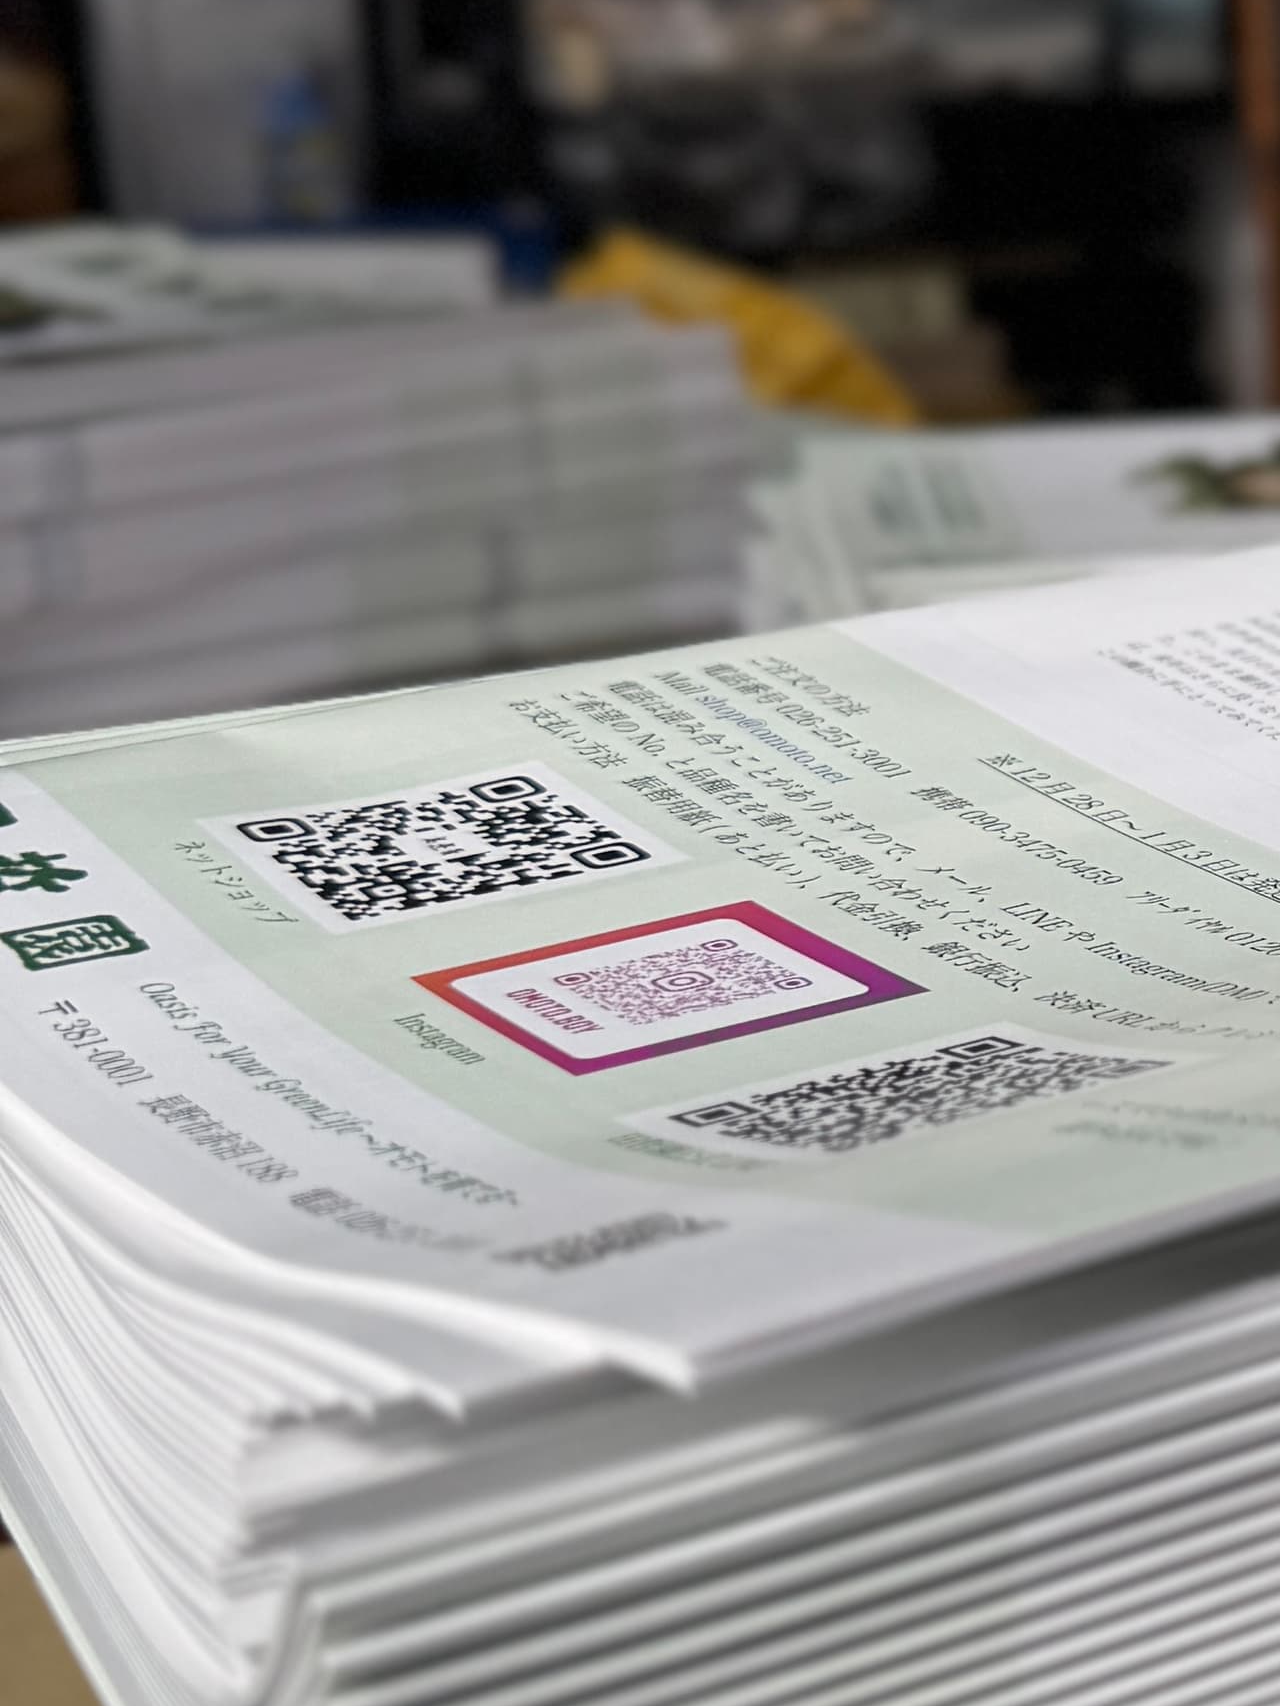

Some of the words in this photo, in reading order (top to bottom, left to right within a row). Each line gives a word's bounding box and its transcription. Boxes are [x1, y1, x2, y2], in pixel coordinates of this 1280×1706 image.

[655, 669, 709, 695] Mail
[695, 694, 853, 784] shop@omoto.net
[173, 841, 301, 923] ネットショップ
[139, 980, 198, 1020] Oasis
[172, 1020, 232, 1046] For
[392, 1011, 487, 1067] Instagram
[506, 987, 605, 1035] OMOTO.BOY
